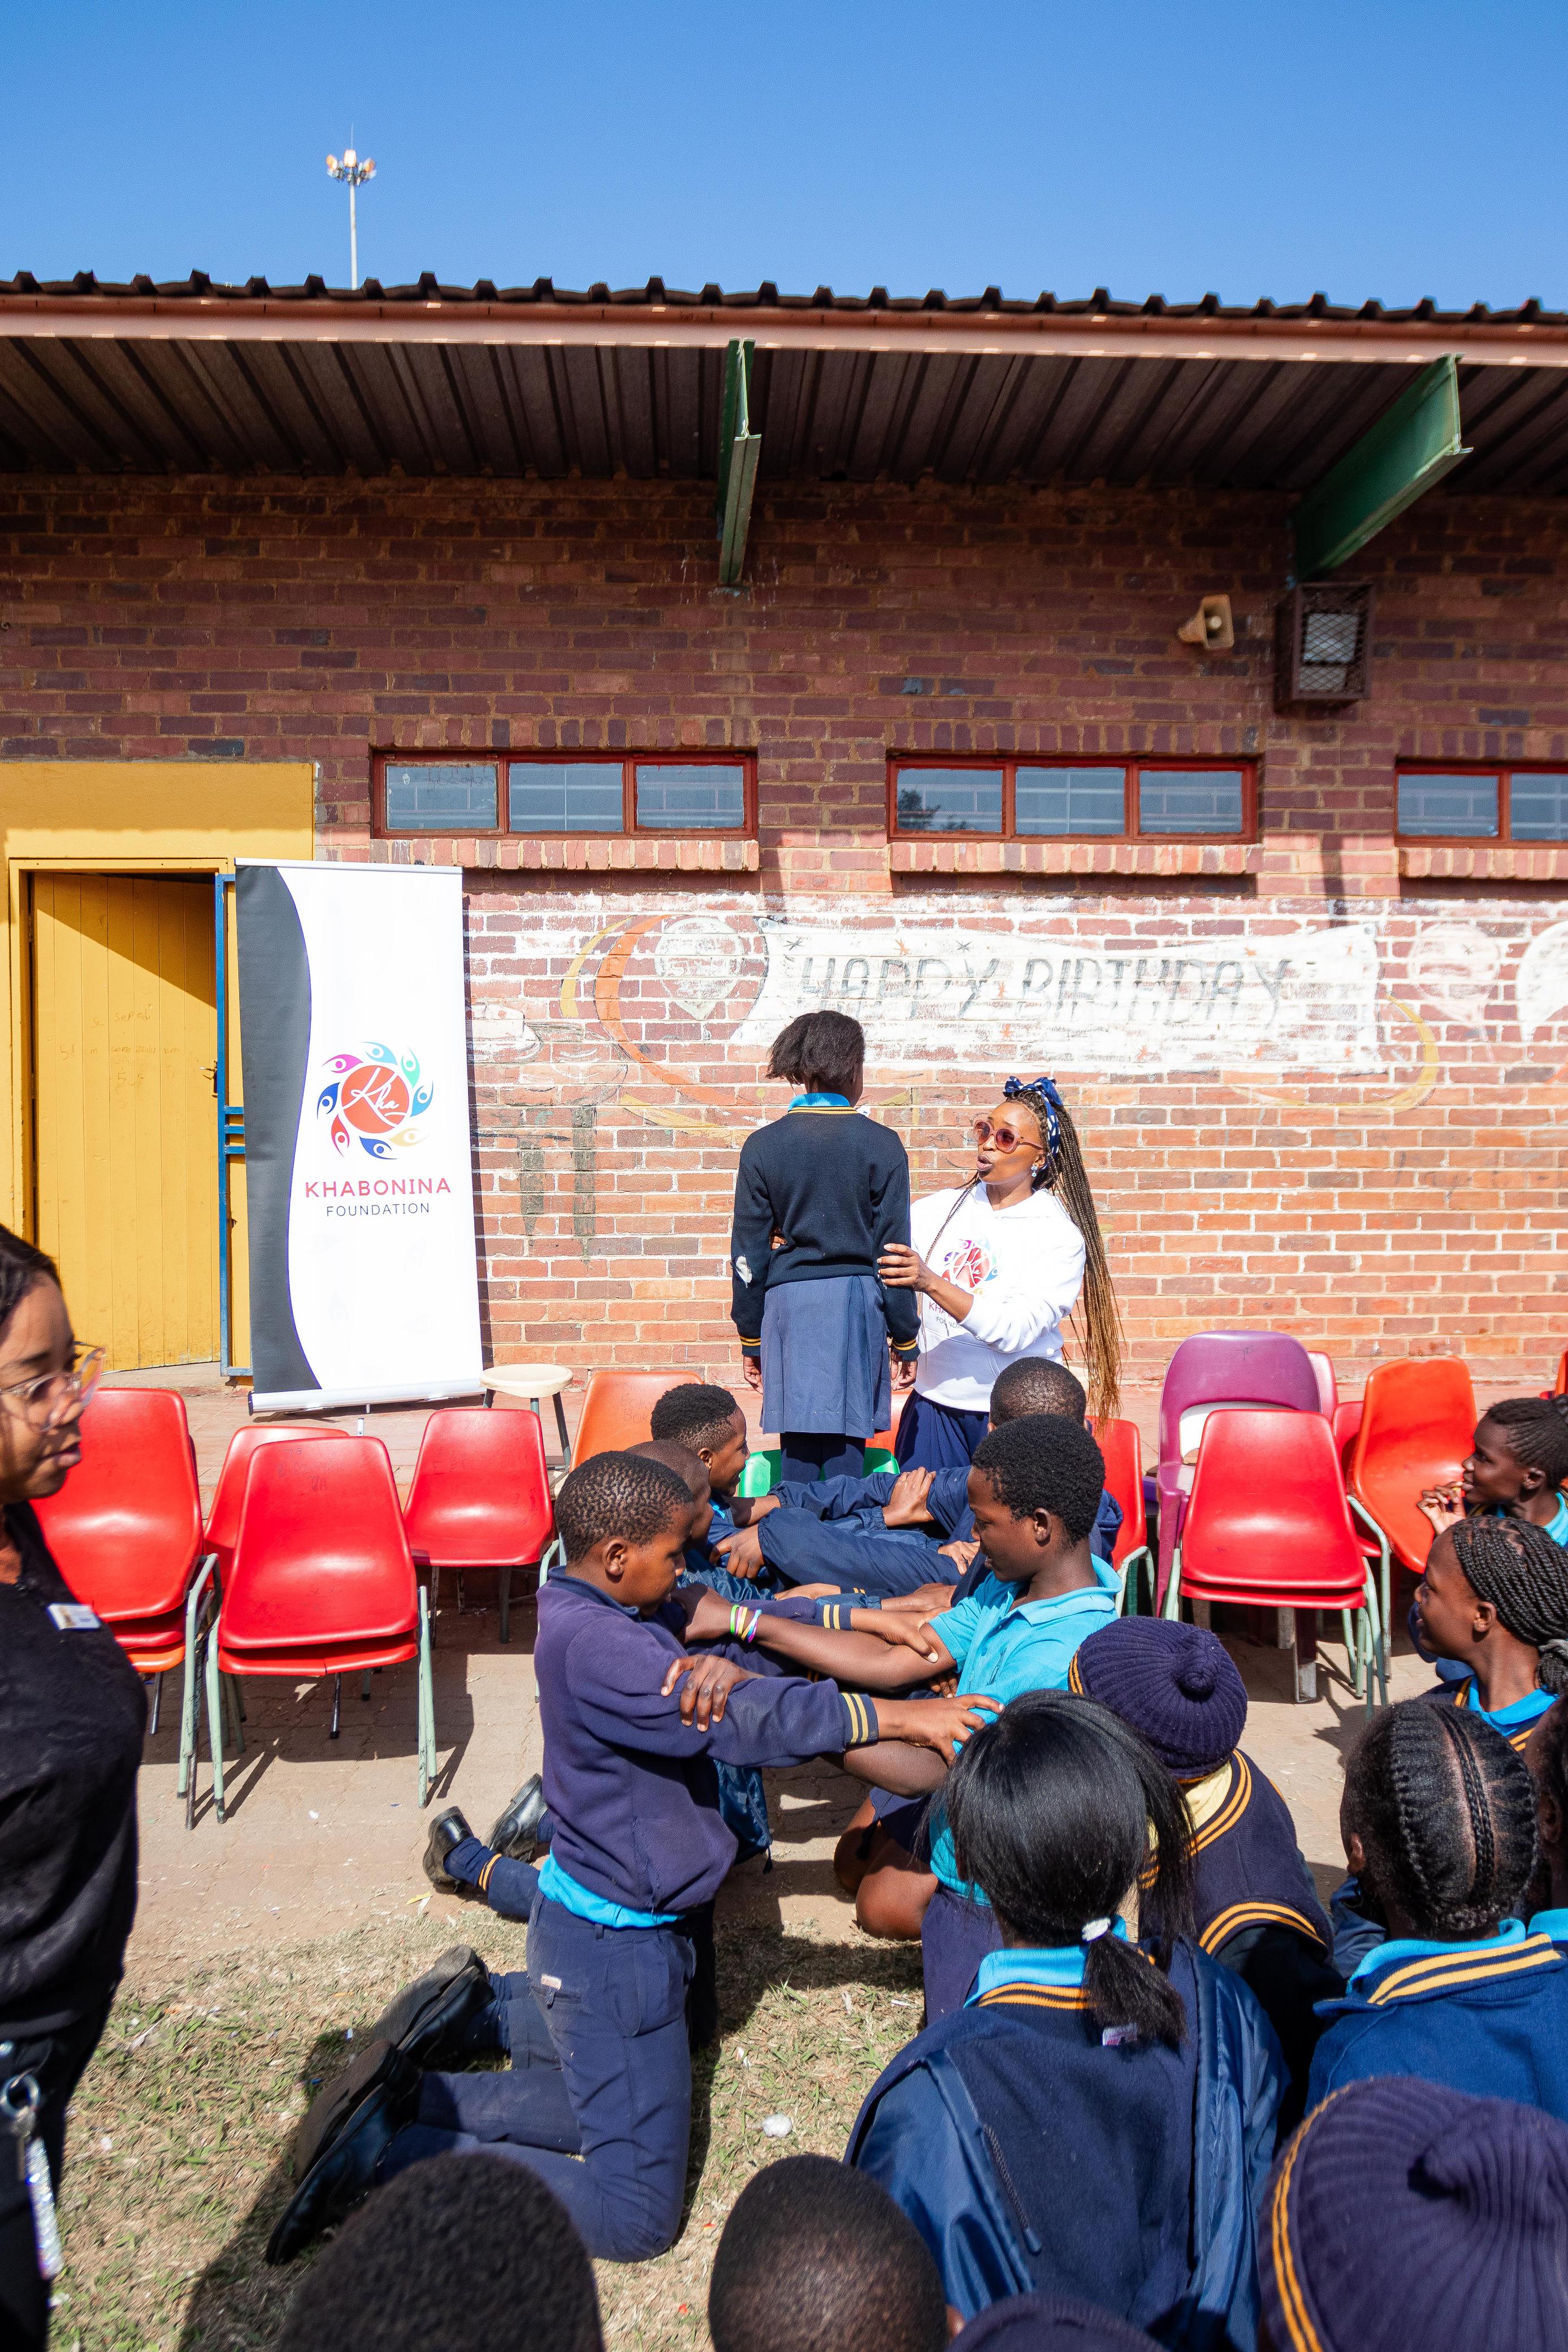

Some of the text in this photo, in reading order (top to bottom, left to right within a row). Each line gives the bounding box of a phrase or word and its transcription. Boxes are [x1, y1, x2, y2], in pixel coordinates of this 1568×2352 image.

[796, 957, 1292, 1030] HAPPY BIRTHDAY
[342, 1066, 409, 1127] Kha
[305, 1178, 451, 1197] KHABONINA
[326, 1203, 430, 1217] FOUNDATION
